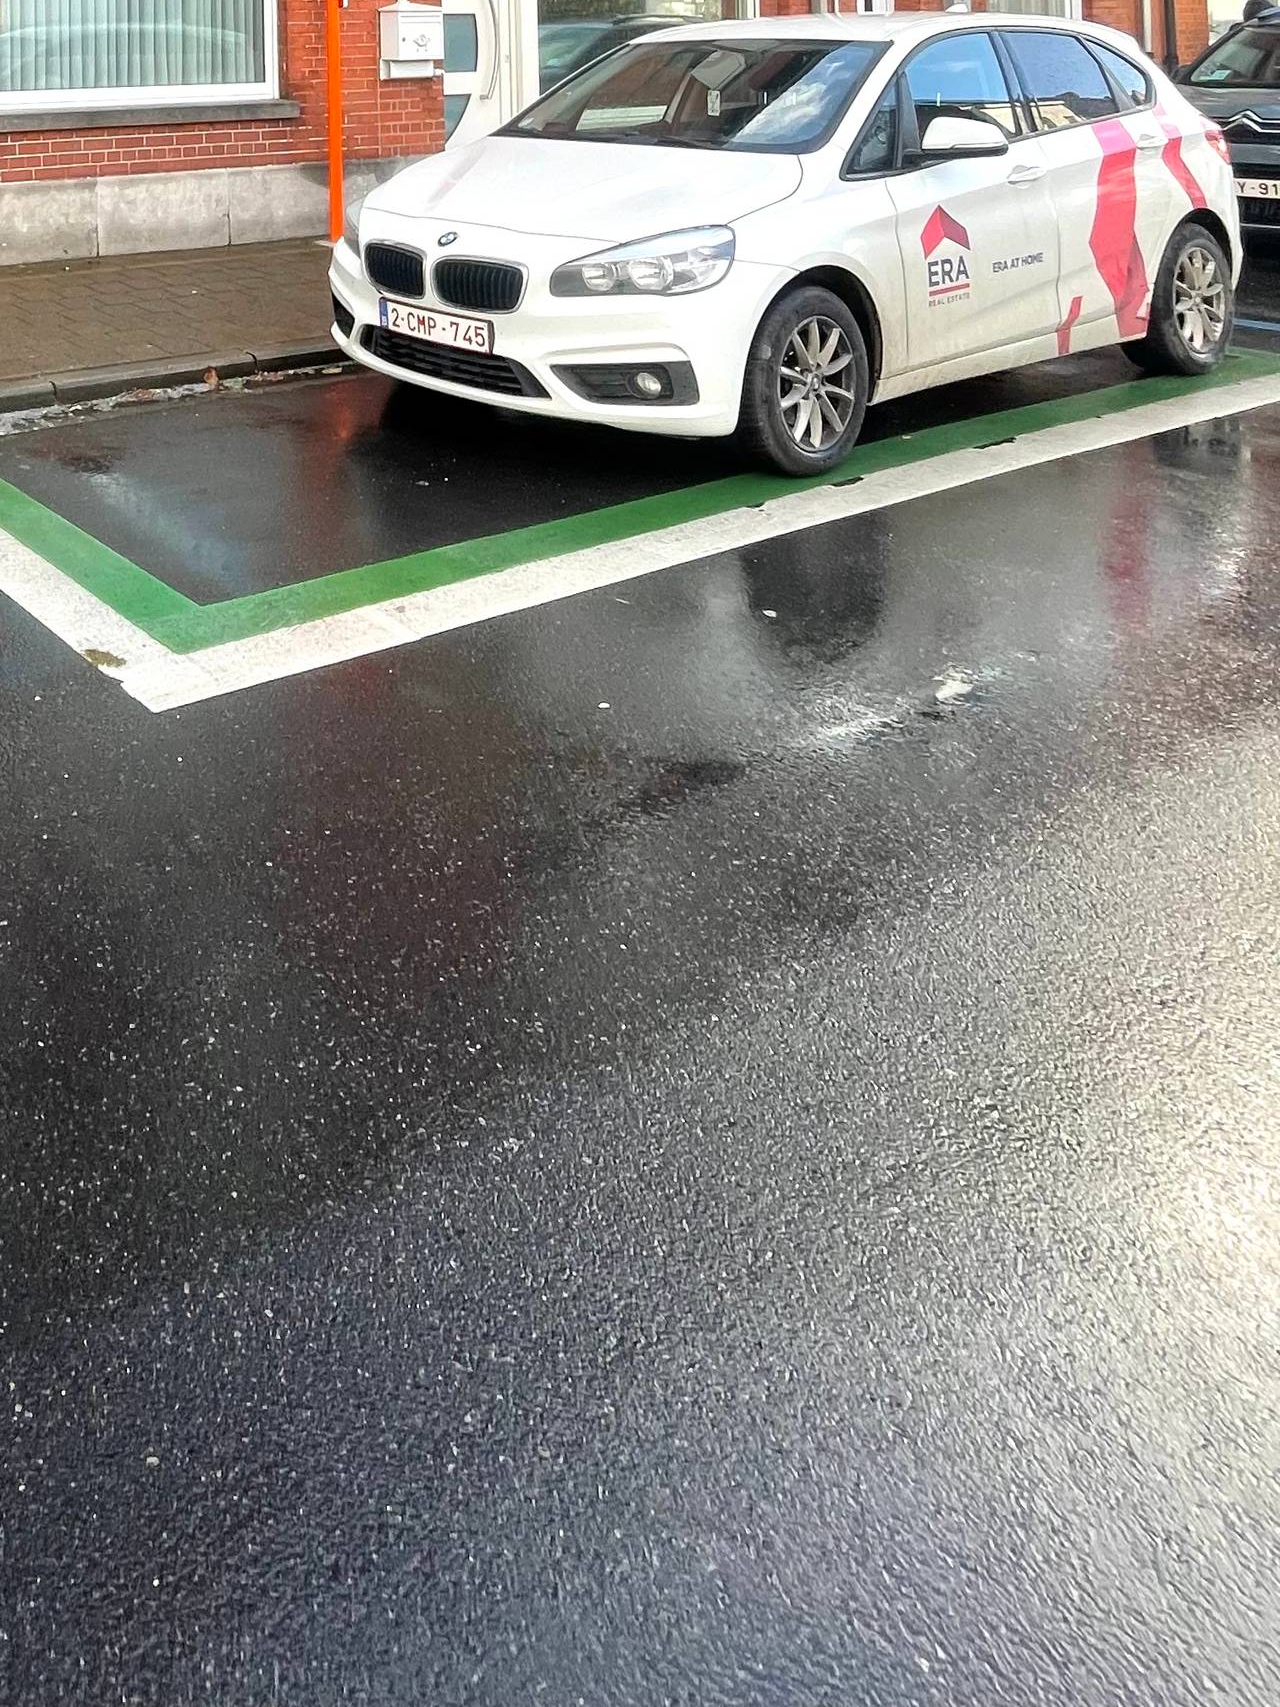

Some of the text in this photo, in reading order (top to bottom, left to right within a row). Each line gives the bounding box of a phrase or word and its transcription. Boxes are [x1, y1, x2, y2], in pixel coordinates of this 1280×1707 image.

[928, 255, 970, 288] ERA
[992, 252, 1044, 273] ERA AT HOME
[928, 299, 946, 308] REAL
